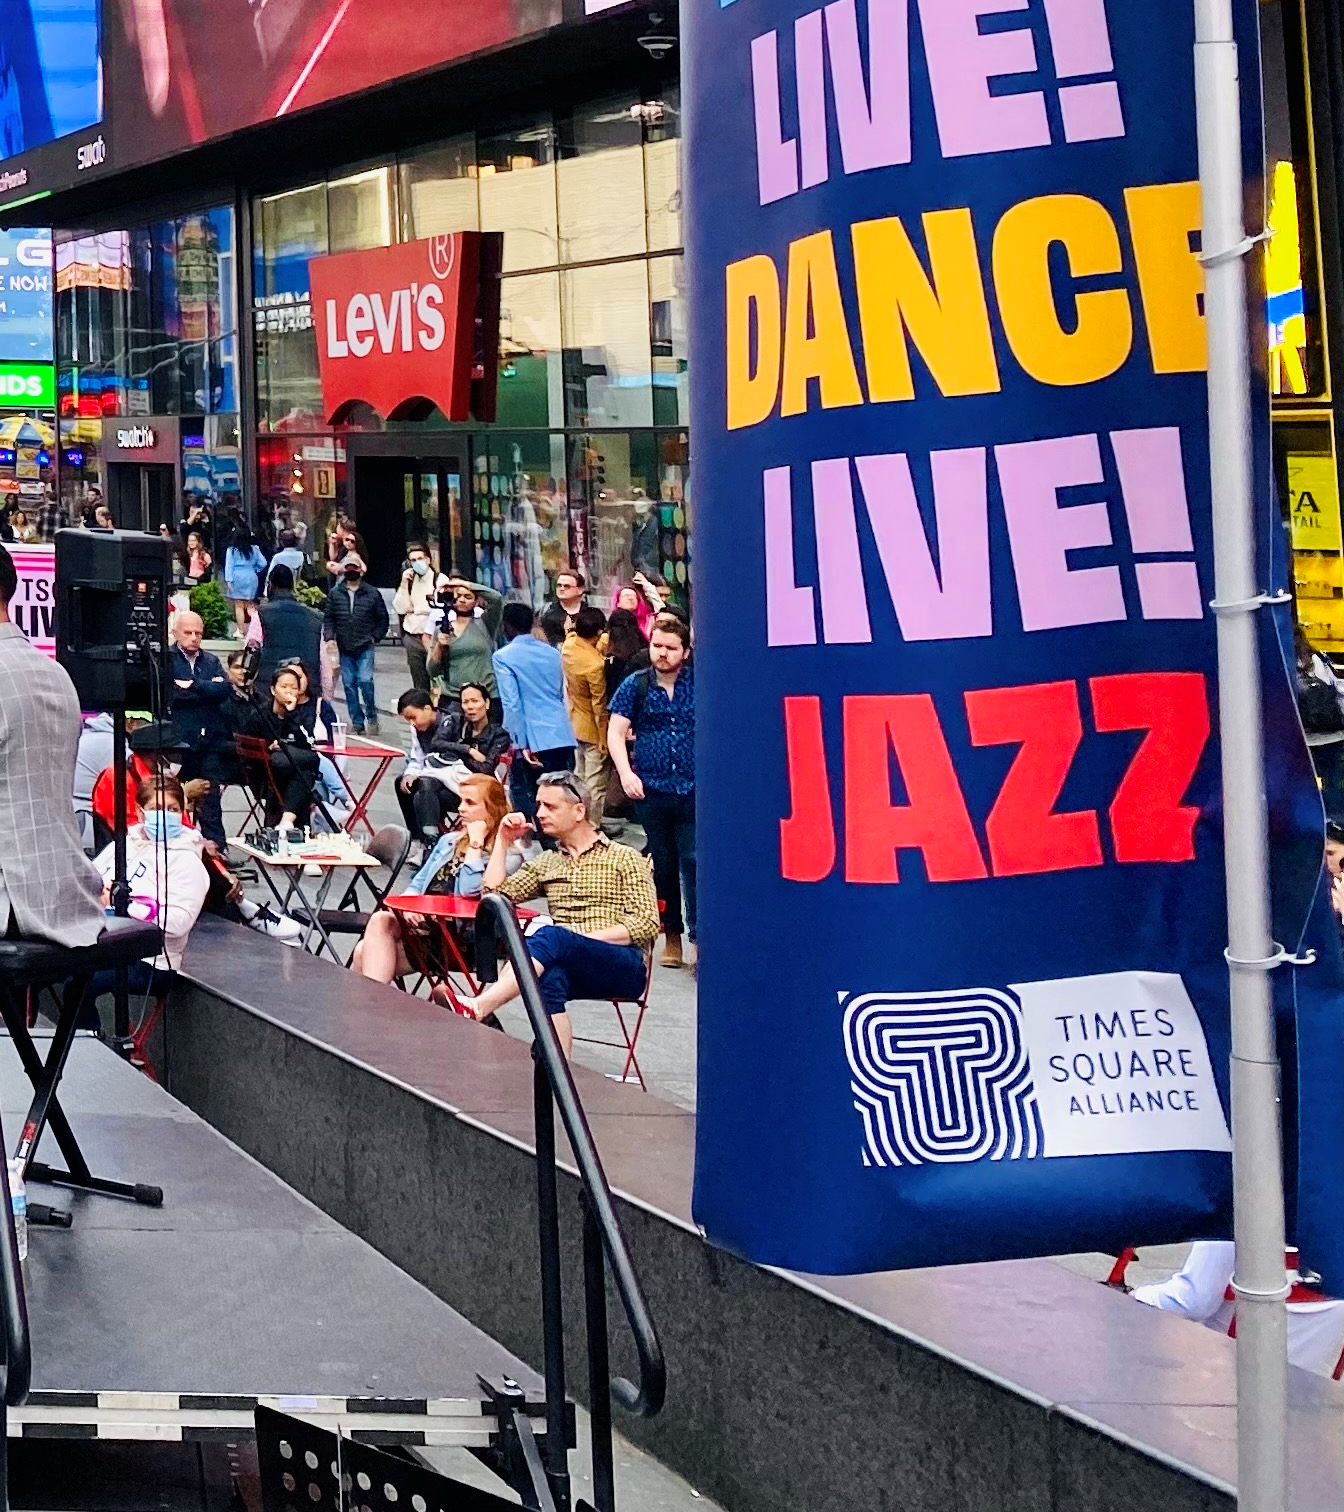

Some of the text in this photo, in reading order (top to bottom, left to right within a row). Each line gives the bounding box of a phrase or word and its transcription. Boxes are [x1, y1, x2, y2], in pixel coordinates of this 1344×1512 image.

[16, 236, 53, 267] G
[9, 274, 48, 292] NOW
[724, 180, 1209, 431] DANCE
[117, 426, 150, 448] swatch
[763, 426, 1204, 647] LIVE!
[22, 578, 55, 601] TS
[15, 605, 55, 637] LIV
[779, 670, 1211, 885] JAZZ
[1055, 1007, 1175, 1043] TIMES
[1049, 1049, 1199, 1084] SQUARE
[1069, 1089, 1201, 1118] ALLIANCE
